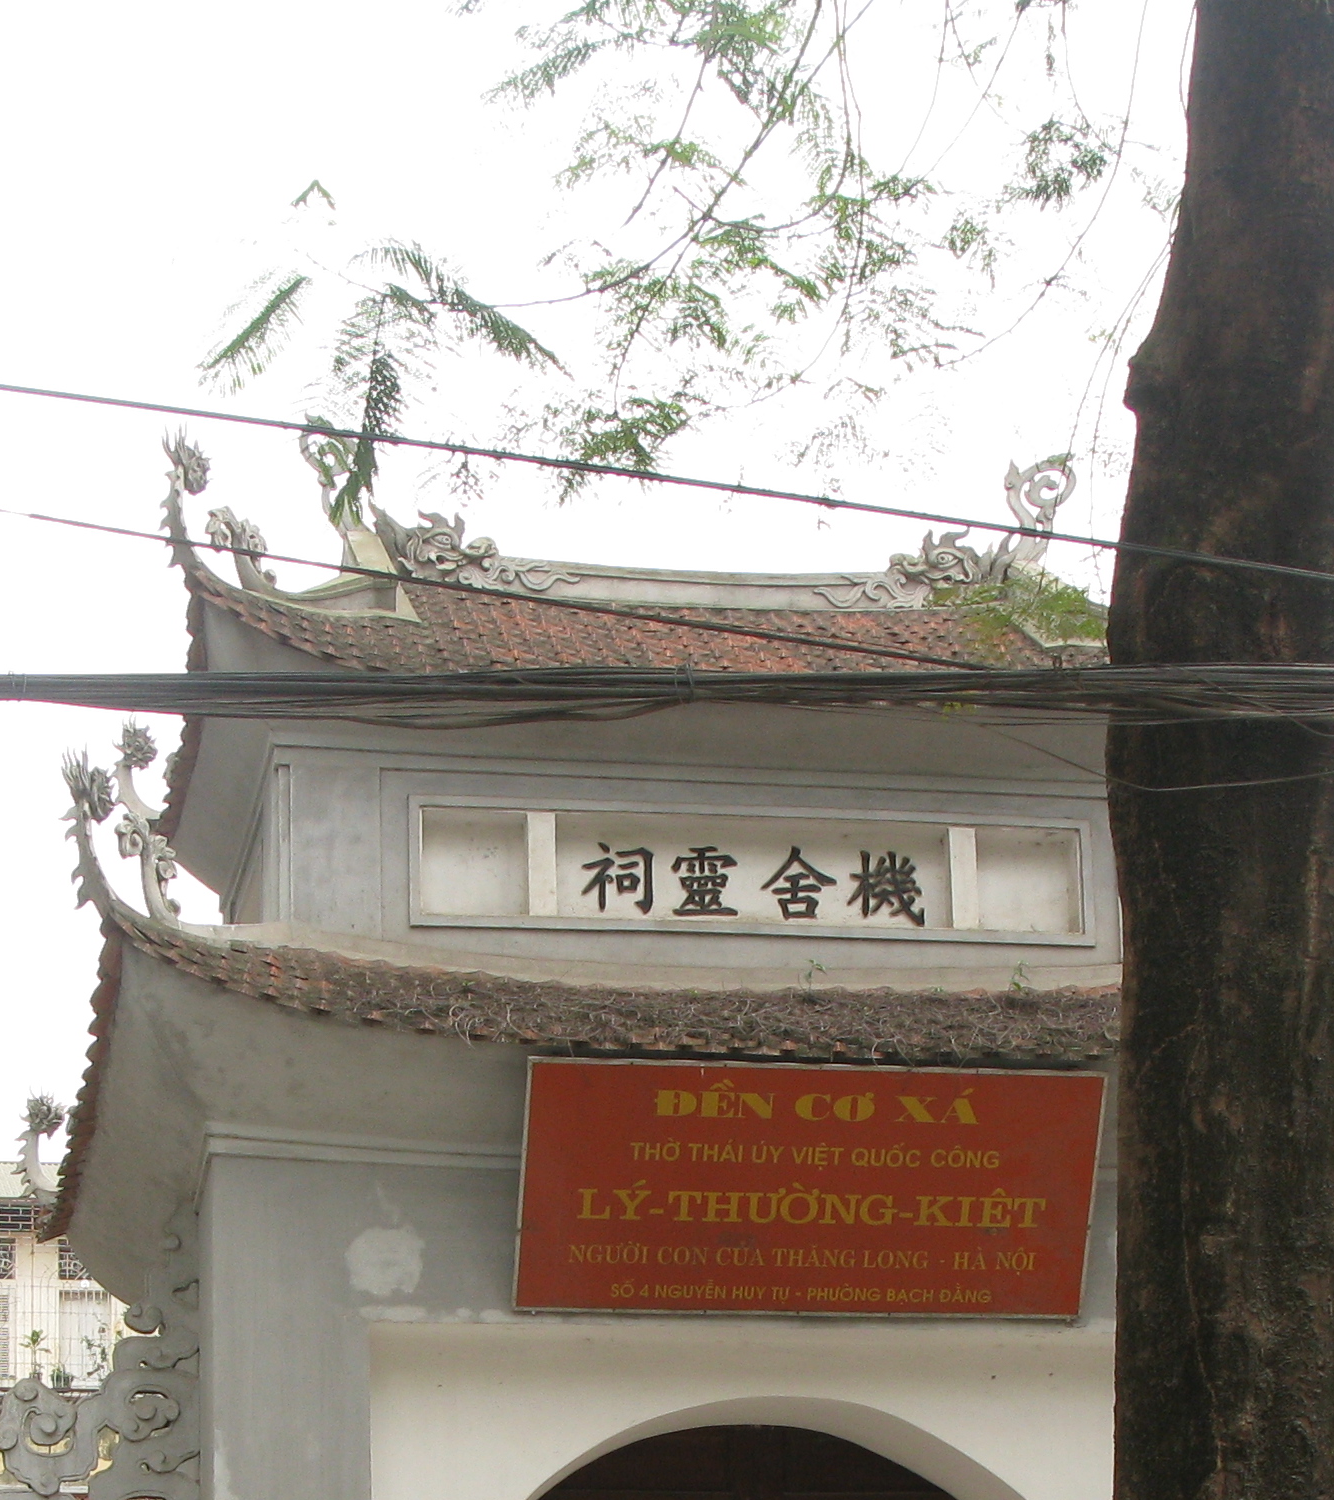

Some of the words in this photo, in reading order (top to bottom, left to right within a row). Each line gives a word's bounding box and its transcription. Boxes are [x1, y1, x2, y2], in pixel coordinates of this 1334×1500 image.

[654, 1079, 775, 1119] ĐỀN
[794, 1092, 875, 1121] CƠ
[894, 1088, 979, 1124] XÁ
[630, 1138, 681, 1161] THỜ
[688, 1139, 744, 1162] THÁI
[791, 1143, 844, 1170] VIỆT
[851, 1142, 921, 1167] QUỐC
[931, 1146, 1000, 1168] CÔNG
[568, 1241, 650, 1264] NGƯỜI
[657, 1246, 709, 1265] CON
[716, 1241, 765, 1266] CỦA
[772, 1244, 856, 1268] THĂNG
[862, 1249, 929, 1270] LONG
[952, 1247, 987, 1270] HÀ
[996, 1247, 1037, 1276] NỘI
[610, 1278, 635, 1298] SỐ
[639, 1284, 649, 1298] 4
[654, 1279, 727, 1299] NGUYỄN
[732, 1286, 766, 1300] HUY
[771, 1286, 791, 1305] TỰ
[807, 1284, 882, 1302] PHƯỜNG
[886, 1288, 935, 1305] BẠCH
[938, 1283, 992, 1303] ĐẰNG
